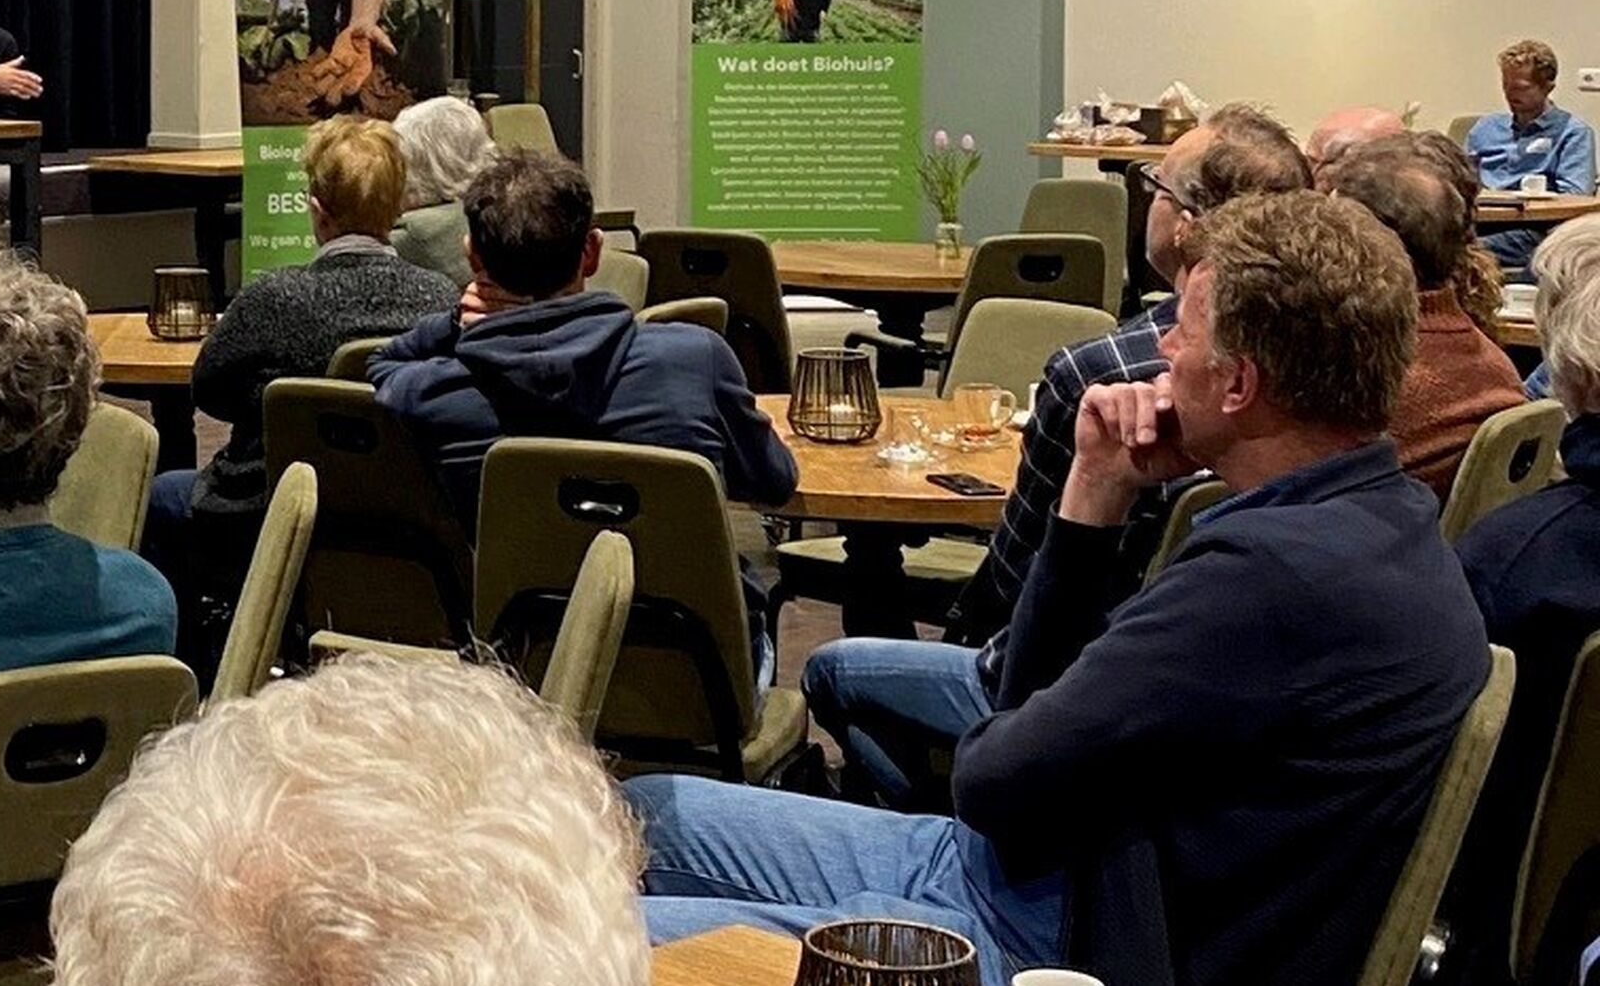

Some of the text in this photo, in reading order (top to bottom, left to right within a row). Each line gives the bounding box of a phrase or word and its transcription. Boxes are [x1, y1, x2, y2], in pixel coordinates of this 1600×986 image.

[718, 56, 895, 73] Wat doet Biohuis?
